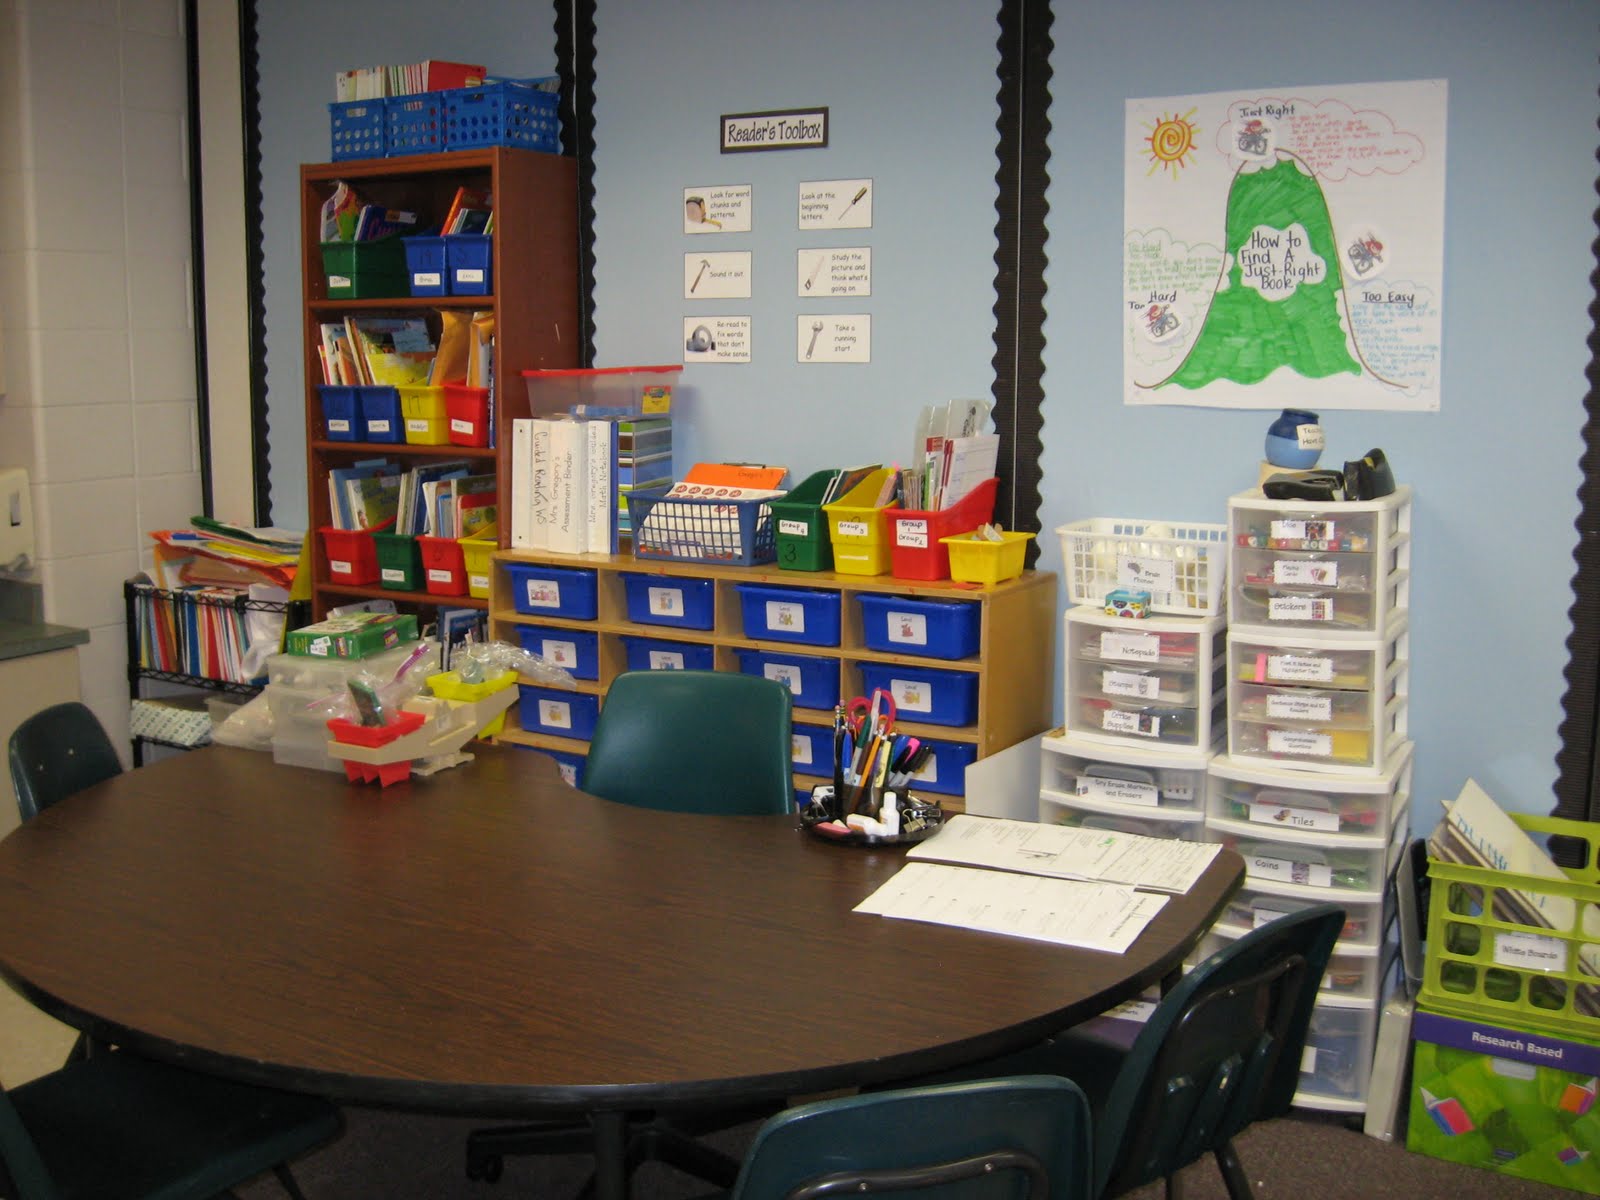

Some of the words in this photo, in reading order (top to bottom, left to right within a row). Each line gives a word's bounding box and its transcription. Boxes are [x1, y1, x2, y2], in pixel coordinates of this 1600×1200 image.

[1266, 105, 1296, 120] Right
[728, 121, 776, 142] Reader's
[778, 120, 821, 140] Toolbox
[802, 203, 829, 212] beginning
[1252, 230, 1279, 249] How
[1286, 230, 1301, 248] to
[1241, 249, 1271, 264] Find
[1284, 248, 1294, 262] A
[1244, 262, 1320, 284] Just-Right
[1261, 275, 1294, 290] Book
[1148, 290, 1177, 304] Hard
[1362, 292, 1382, 302] Too
[1388, 292, 1414, 308] Easy
[534, 431, 548, 463] Guided
[564, 451, 573, 479] Binder
[600, 441, 608, 481] Notebook
[550, 456, 562, 500] Gregory's
[531, 469, 548, 506] Reading
[561, 483, 570, 533] Assessment
[781, 522, 800, 530] Group
[899, 535, 919, 543] Group
[785, 543, 796, 562] 3
[1122, 647, 1155, 656] Notepads
[1112, 712, 1131, 720] Office
[1107, 721, 1134, 730] Supplies
[1108, 780, 1126, 788] Erase
[1127, 783, 1154, 791] Markers
[1118, 791, 1142, 799] Erasers
[1292, 816, 1314, 826] Tiles
[1255, 860, 1279, 870] Coins
[1472, 1031, 1524, 1052] Research
[1527, 1042, 1563, 1058] Based
